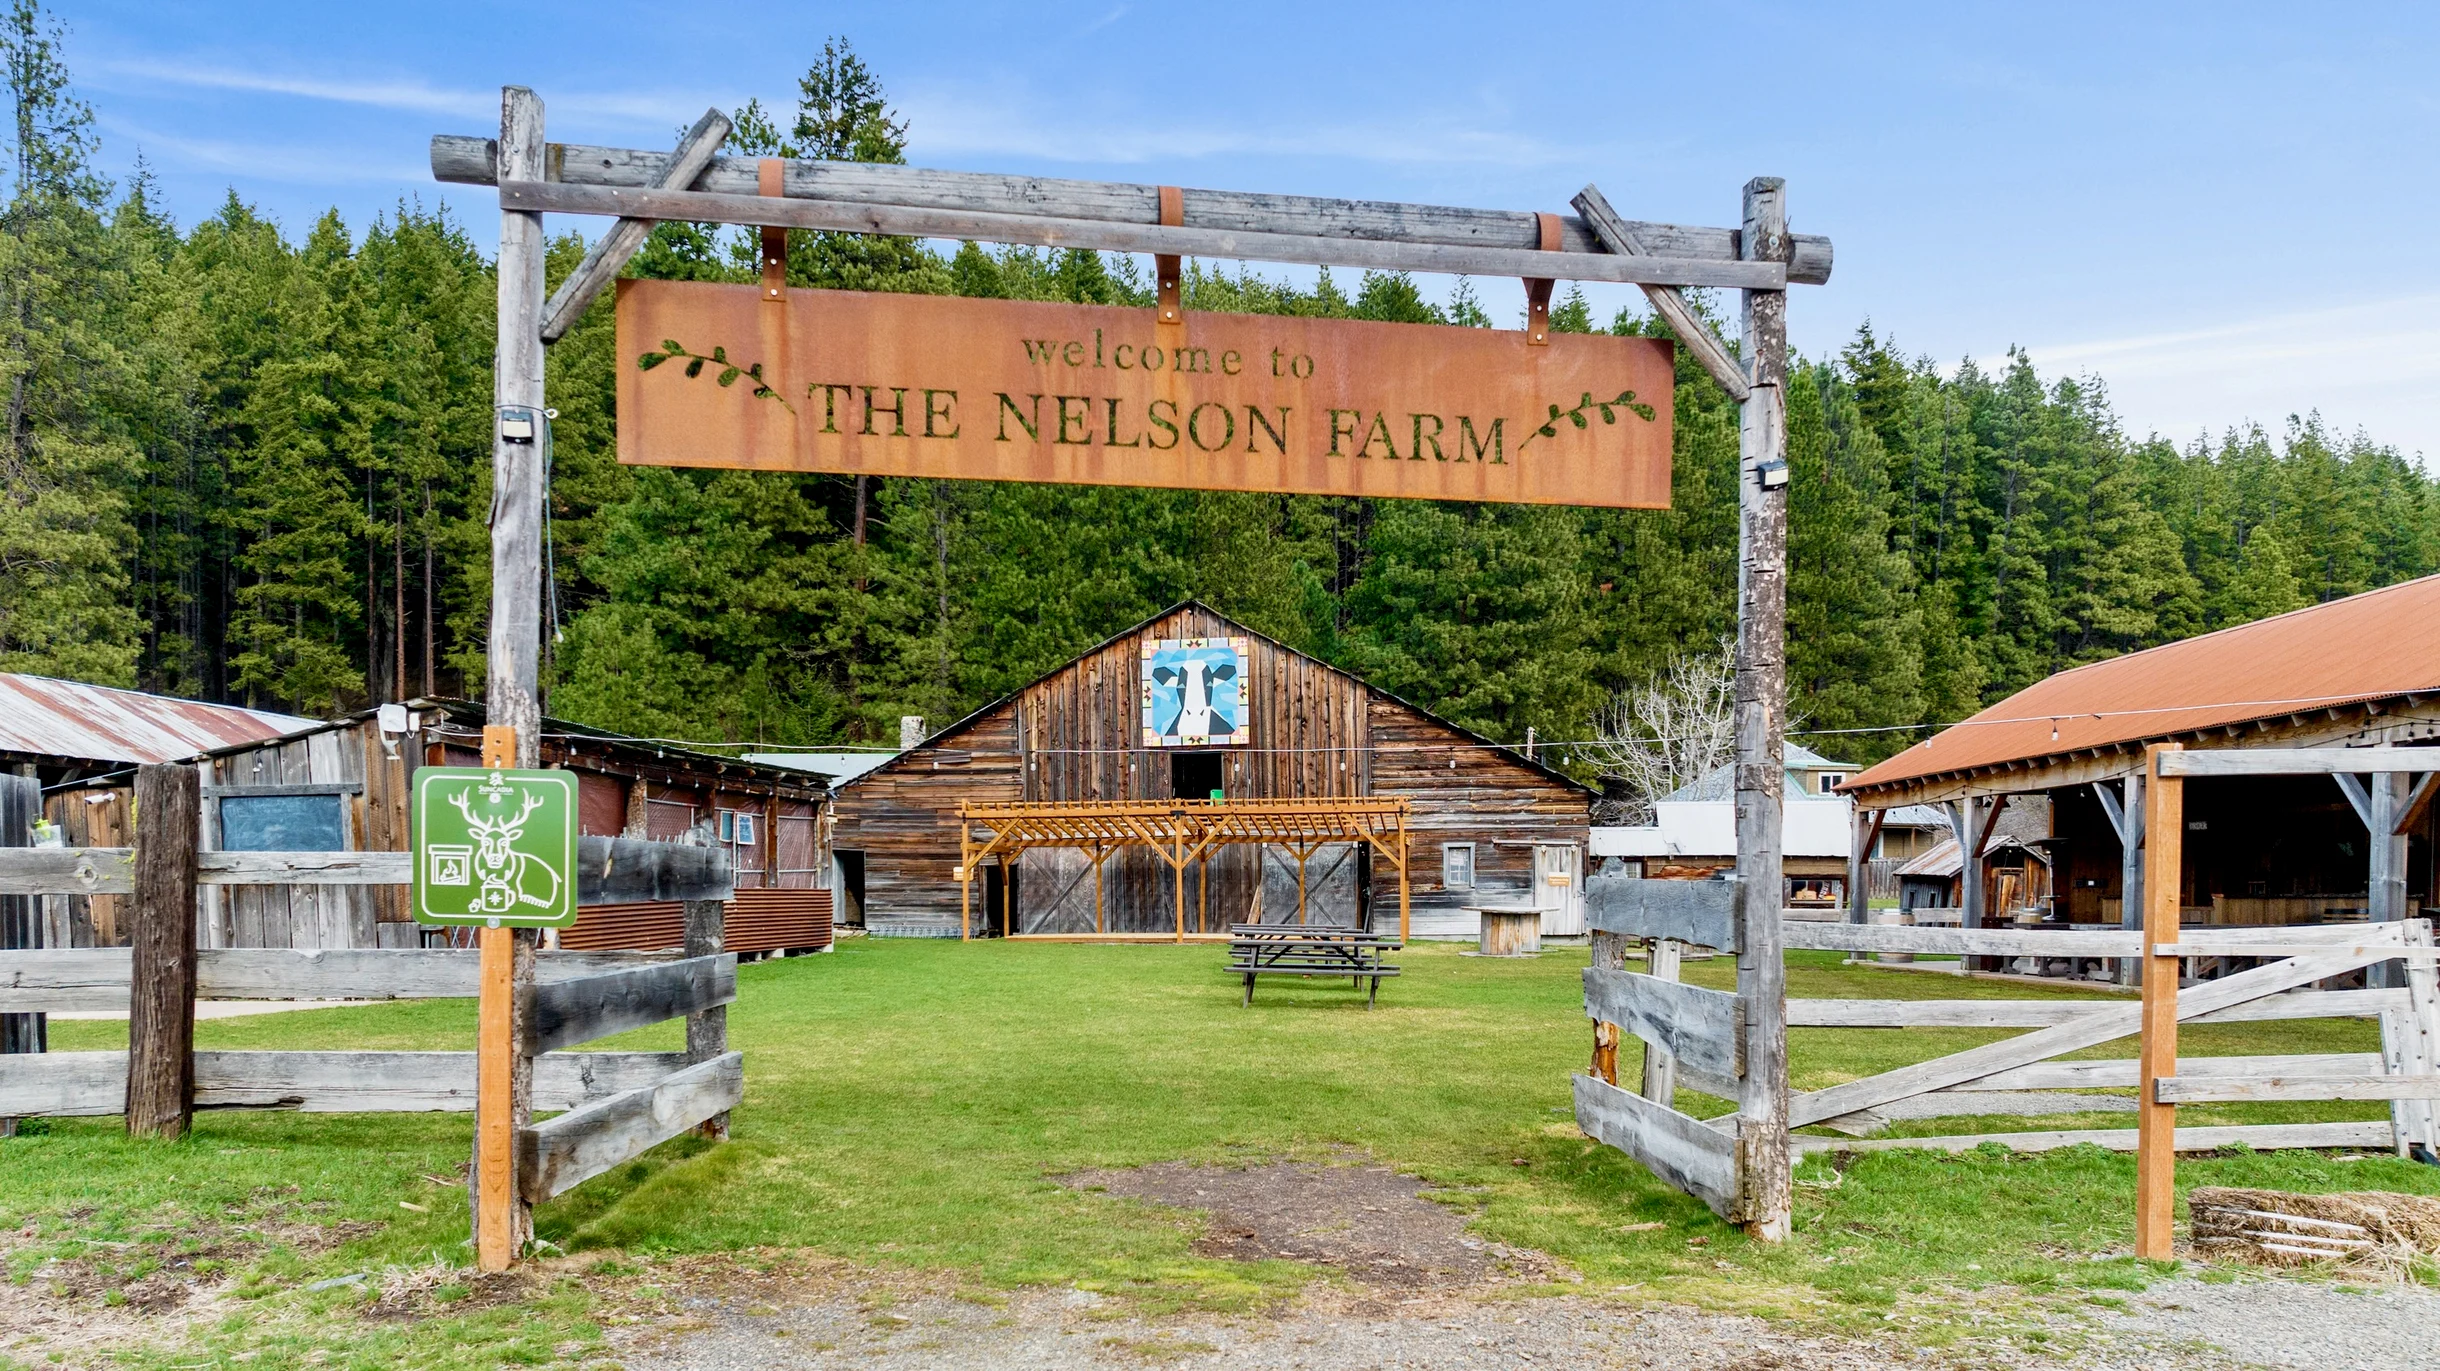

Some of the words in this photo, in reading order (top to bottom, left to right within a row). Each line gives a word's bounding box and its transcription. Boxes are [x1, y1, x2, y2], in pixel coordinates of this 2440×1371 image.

[1021, 327, 1243, 376] welcome
[1271, 346, 1315, 380] to
[807, 382, 961, 440] THE
[992, 391, 1294, 456] NELSON
[1324, 407, 1510, 466] FARM
